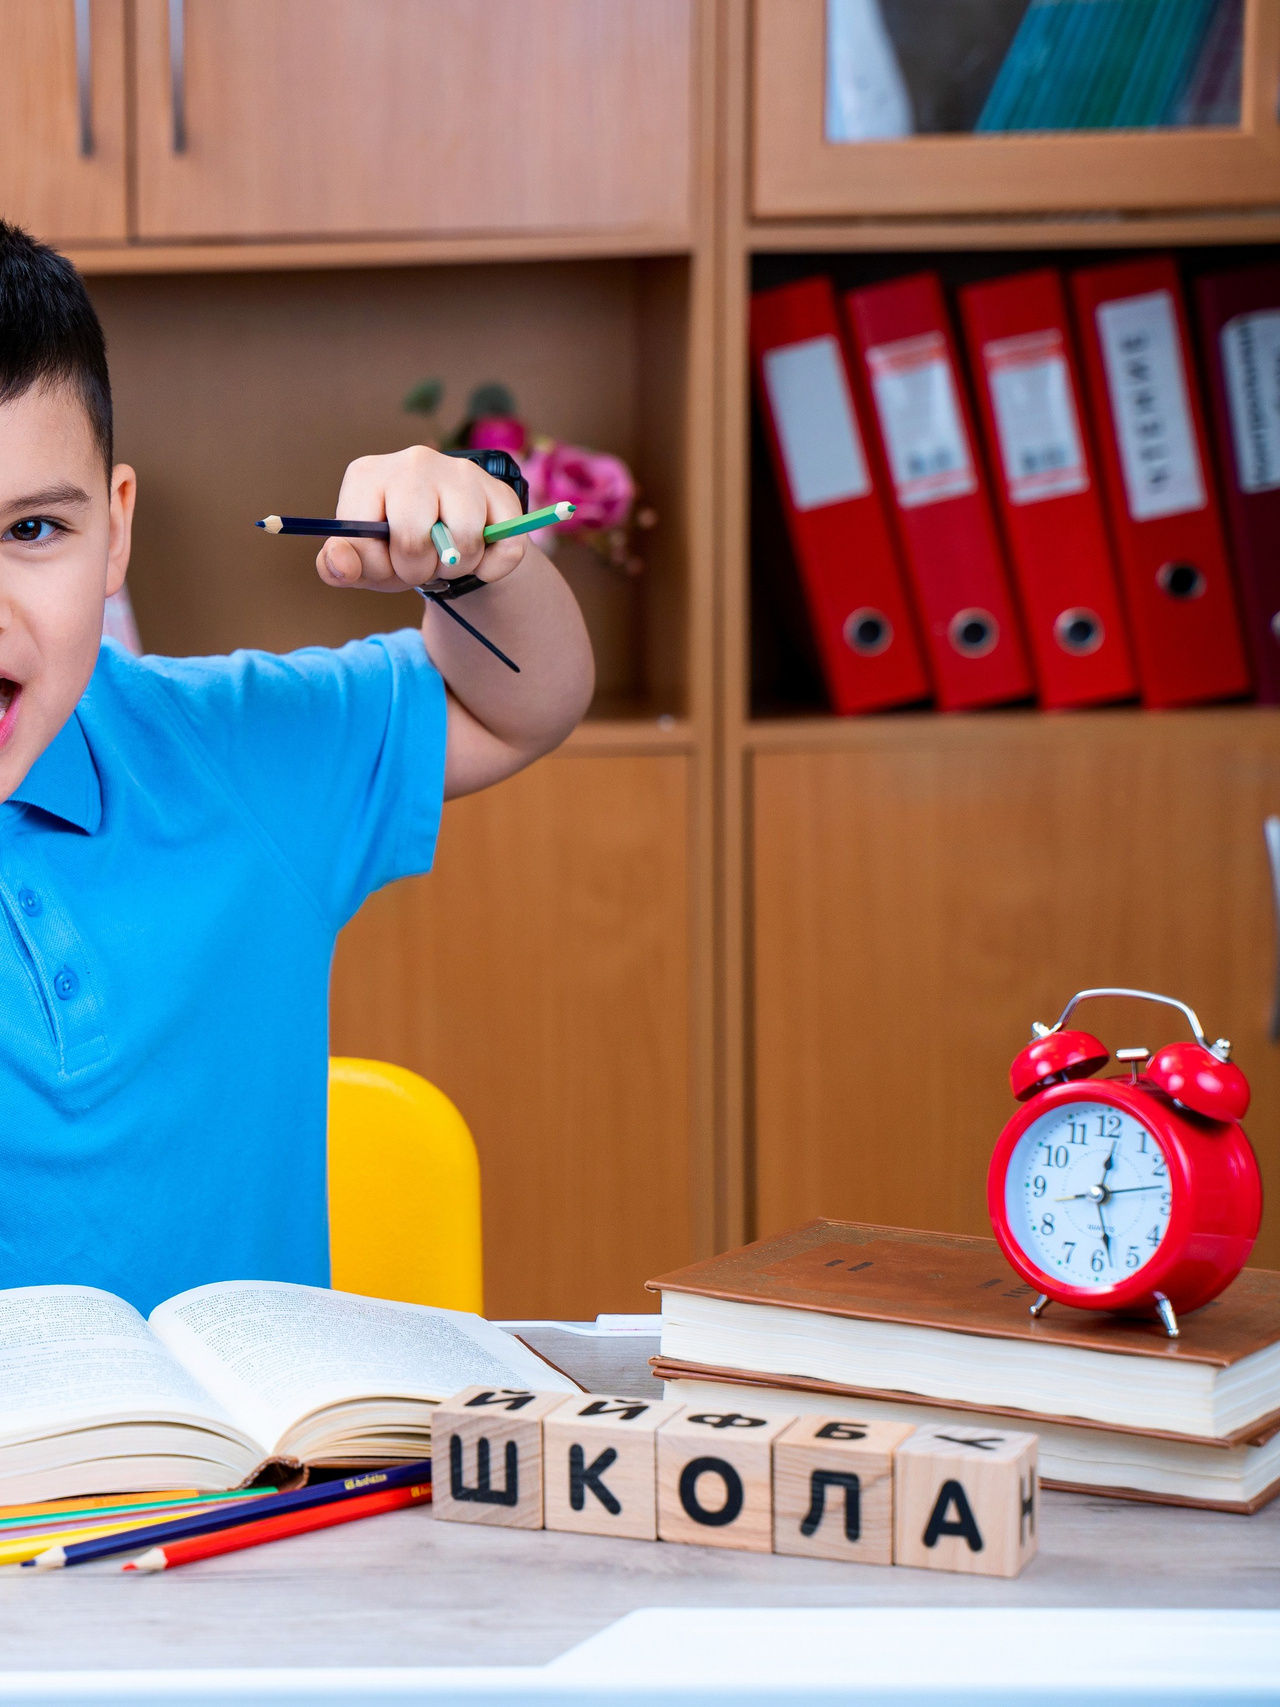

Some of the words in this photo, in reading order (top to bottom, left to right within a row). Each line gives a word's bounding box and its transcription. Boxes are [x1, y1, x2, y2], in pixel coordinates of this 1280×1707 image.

[1066, 1121, 1088, 1145] 11
[1095, 1114, 1121, 1139] 12
[1136, 1131, 1148, 1154] 1
[1042, 1145, 1068, 1168] 10
[1152, 1153, 1166, 1177] 2
[1033, 1175, 1046, 1198] 9
[1159, 1192, 1172, 1216] 3
[1040, 1213, 1054, 1236] 8
[1146, 1224, 1162, 1247] 4
[1063, 1241, 1077, 1264] 7
[1090, 1249, 1105, 1272] 6
[1125, 1246, 1140, 1268] 5
[464, 1390, 537, 1411] Й
[577, 1399, 650, 1421] Й
[687, 1413, 767, 1429] Ф
[814, 1421, 869, 1441] Б
[449, 1433, 984, 1553] ШКОЛА
